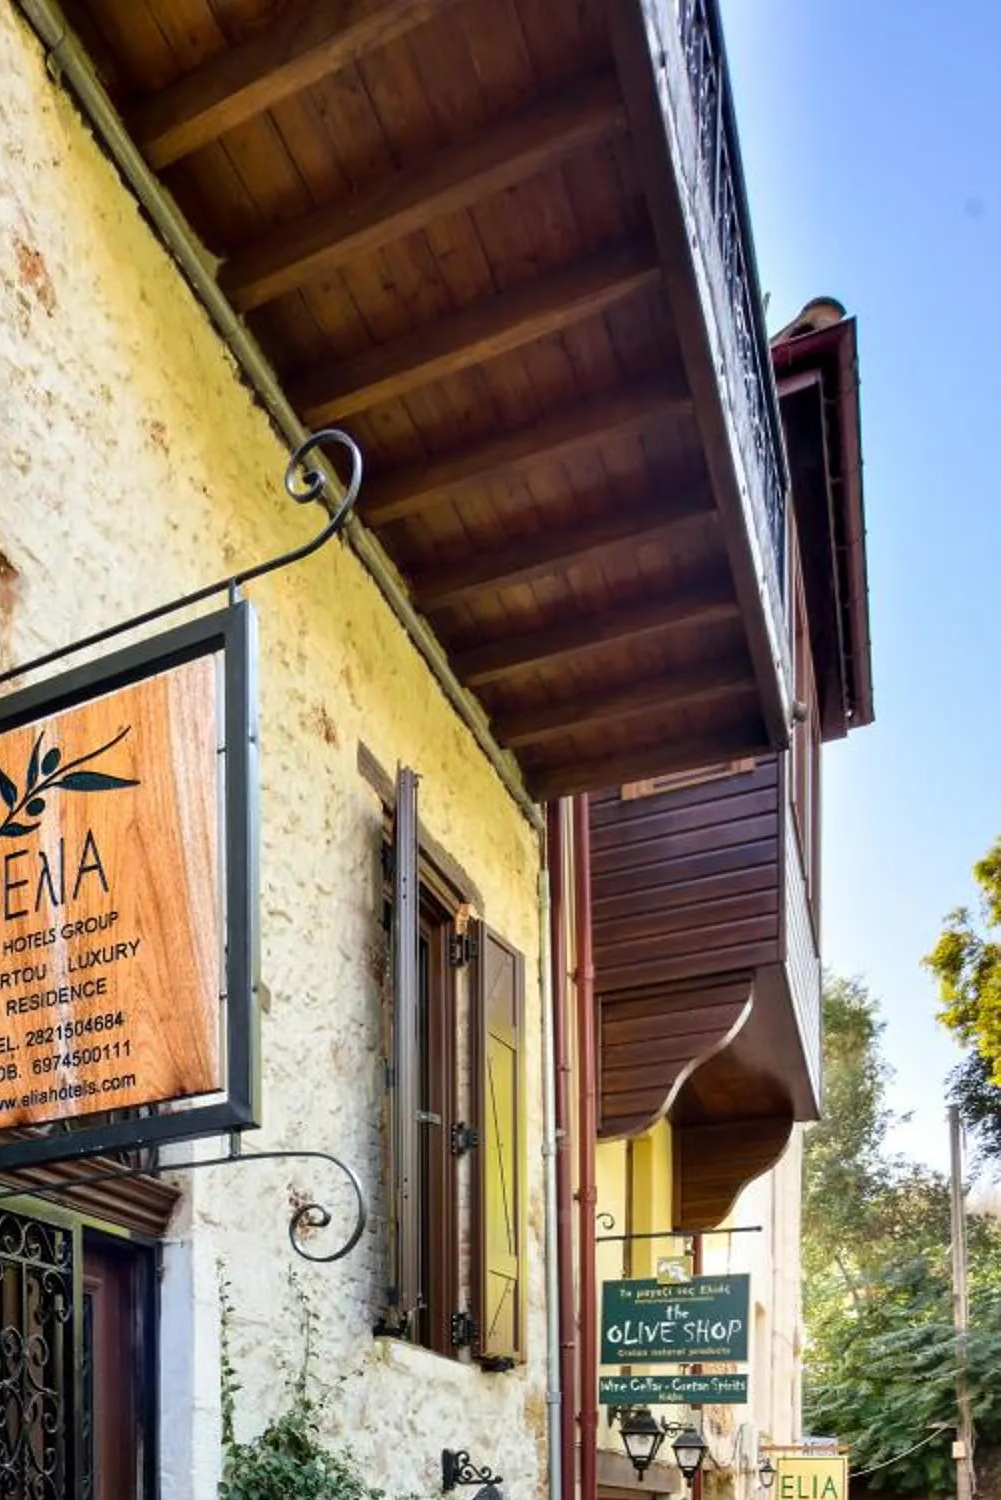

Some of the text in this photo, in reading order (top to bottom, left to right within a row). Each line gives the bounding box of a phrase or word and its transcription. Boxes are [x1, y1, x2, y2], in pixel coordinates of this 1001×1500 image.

[2, 911, 119, 957] HOTELS GROUP
[67, 939, 141, 973] LUXURY
[5, 977, 108, 1017] RESIDENCE
[25, 1011, 125, 1048] 2821504684
[31, 1039, 132, 1076] 6974500111
[666, 1304, 690, 1320] the
[606, 1319, 743, 1345] OLIVE SHOP
[599, 1379, 628, 1392] Wine
[711, 1376, 747, 1394] Spirits
[780, 1474, 839, 1500] ELIA
